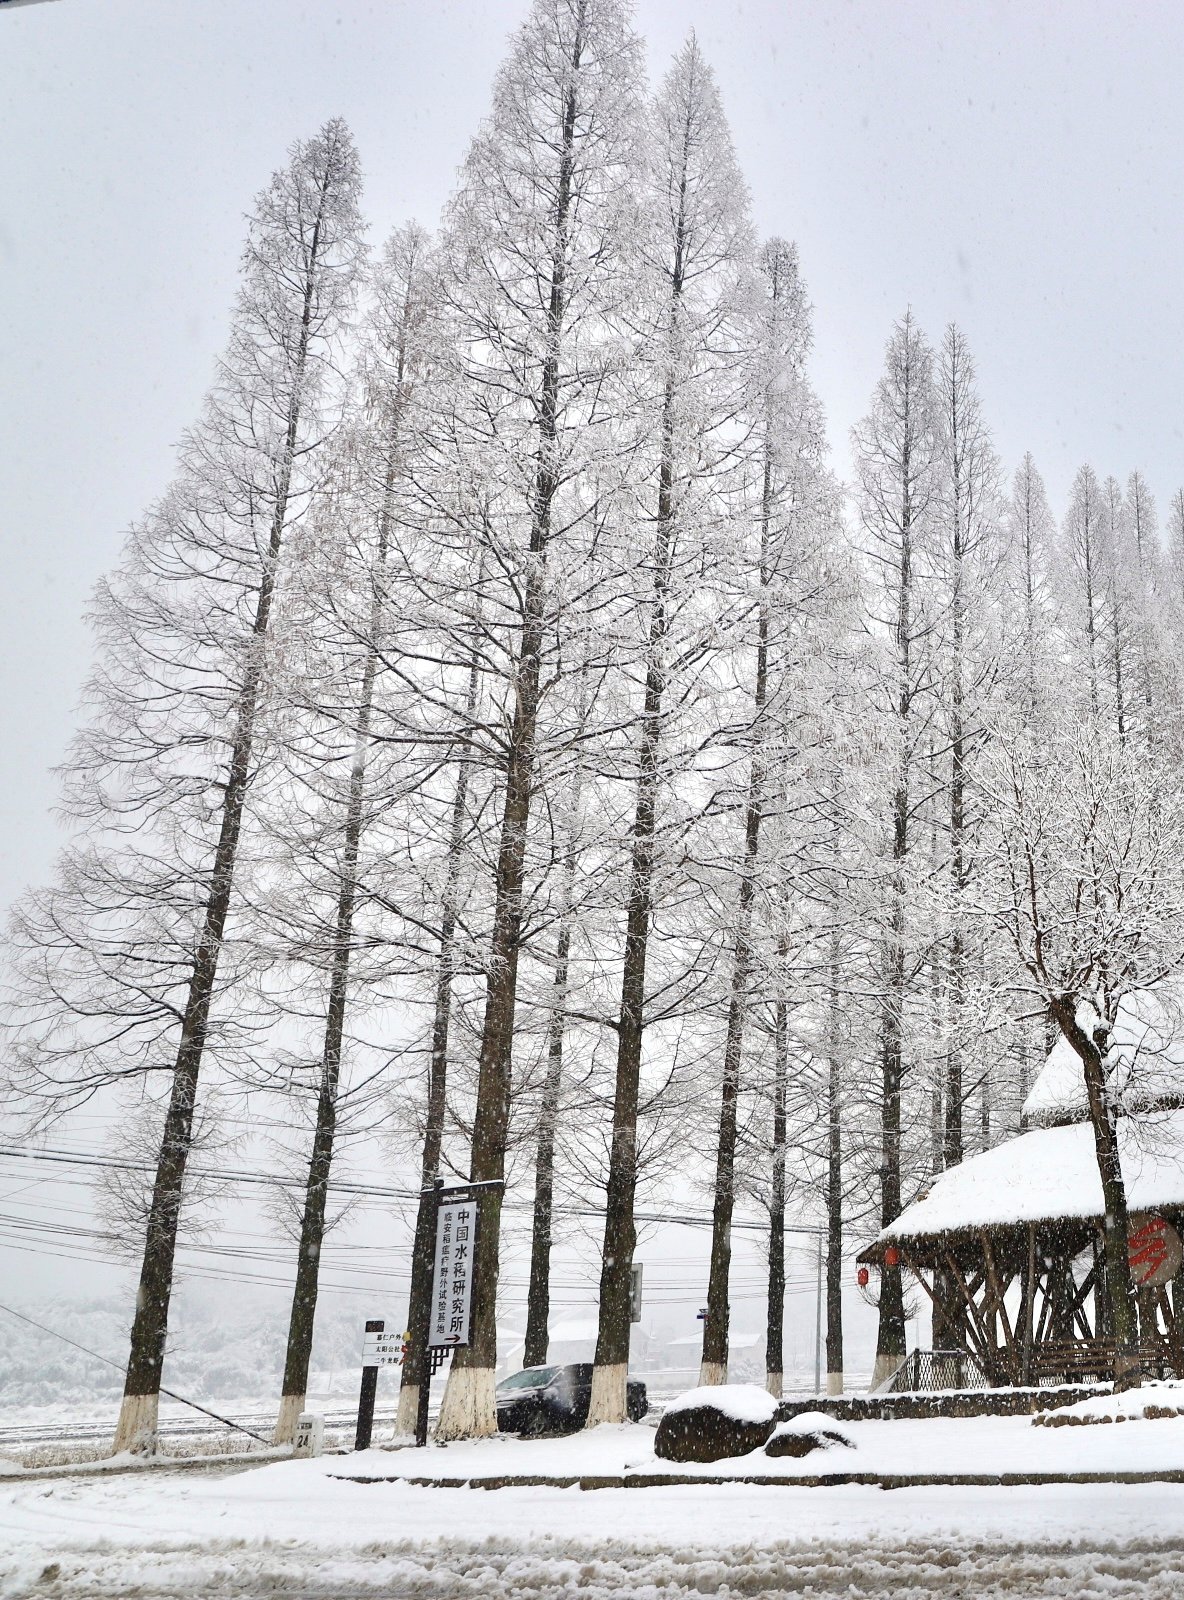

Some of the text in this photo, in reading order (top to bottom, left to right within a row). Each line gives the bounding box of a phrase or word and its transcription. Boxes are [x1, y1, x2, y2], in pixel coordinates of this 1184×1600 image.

[450, 1208, 470, 1332] 中国水稻研究所
